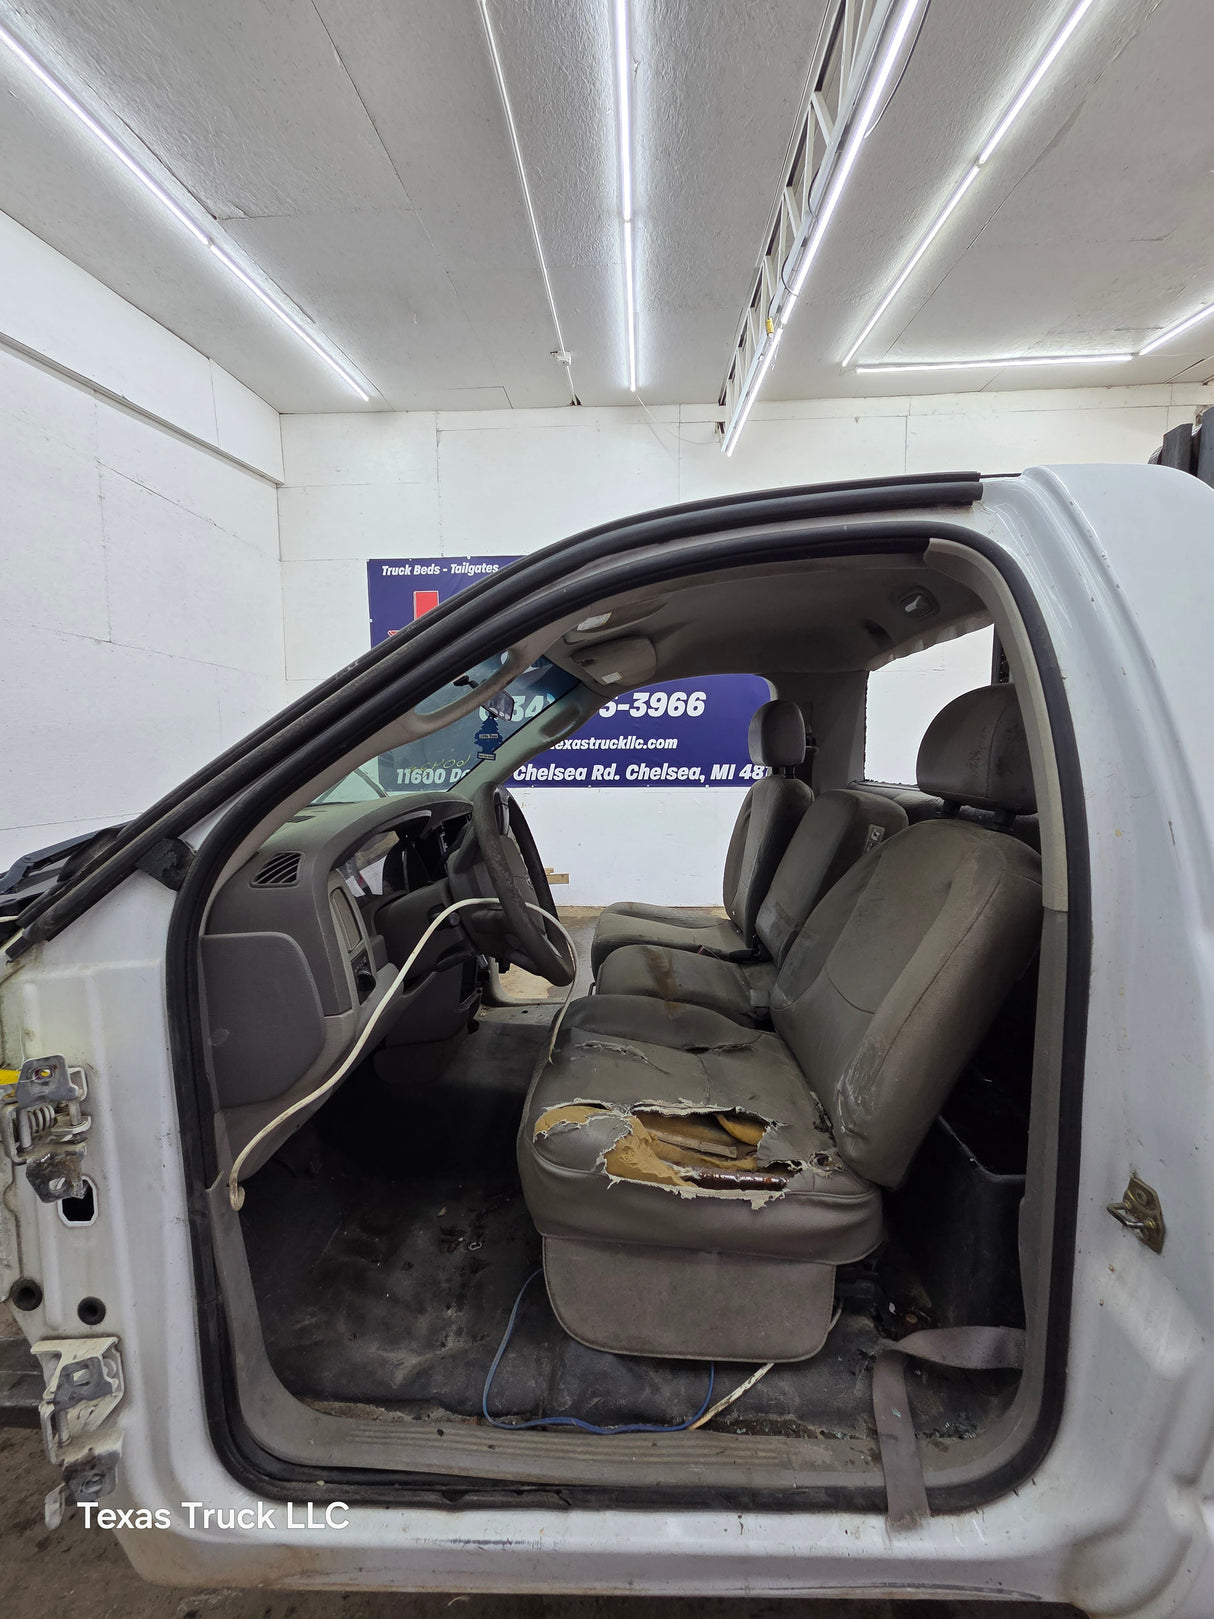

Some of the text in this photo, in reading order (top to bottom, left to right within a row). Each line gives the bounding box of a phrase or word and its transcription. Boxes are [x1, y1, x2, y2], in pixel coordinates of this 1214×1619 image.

[382, 564, 411, 576] Truck
[413, 563, 440, 575] Beds
[450, 562, 500, 576] Tailgates
[550, 735, 678, 750] exastruckllc.com
[396, 768, 446, 785] 11600
[513, 763, 587, 780] Chelsea
[591, 763, 620, 780] Rd.
[625, 763, 705, 783] Chelsea,
[710, 763, 736, 780] MI
